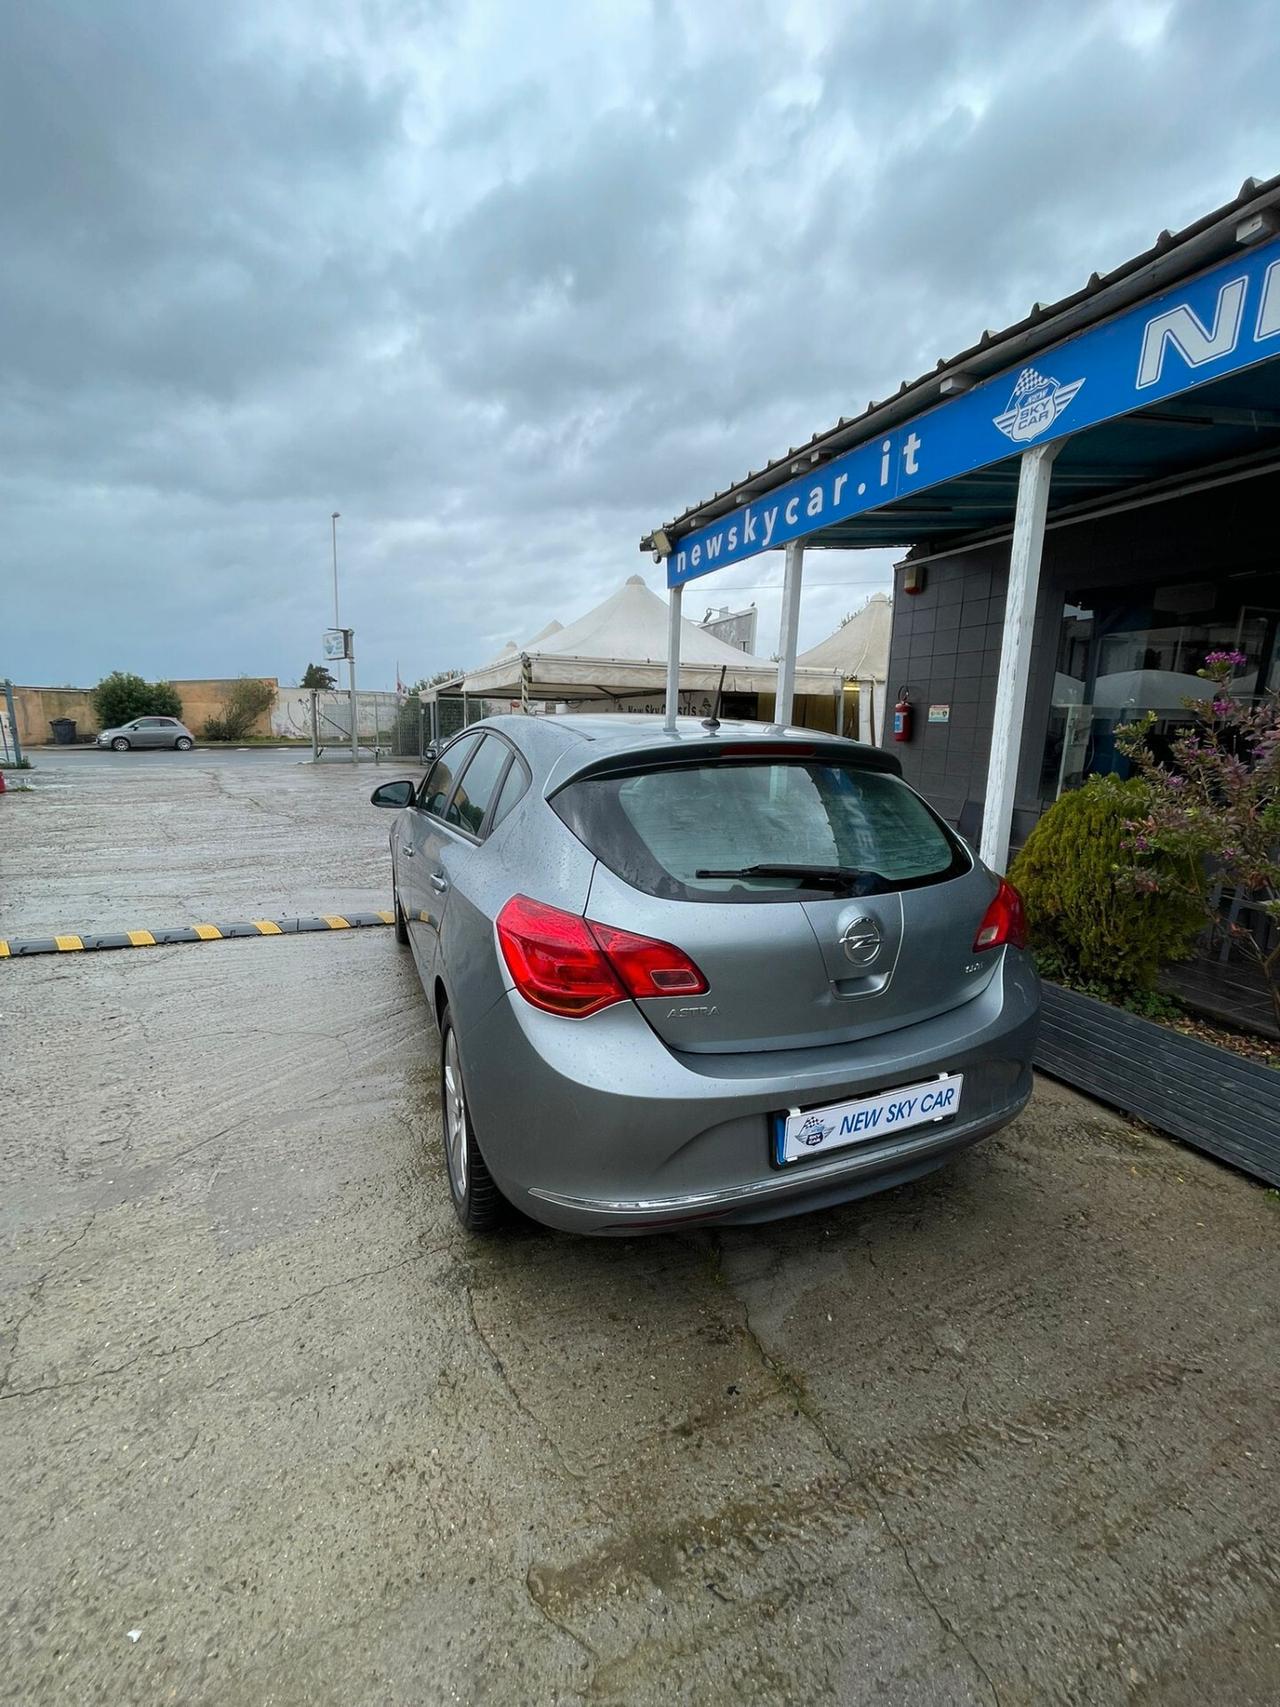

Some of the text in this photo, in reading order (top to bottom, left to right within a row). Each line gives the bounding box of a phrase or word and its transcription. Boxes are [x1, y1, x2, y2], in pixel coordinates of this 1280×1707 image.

[1020, 399, 1051, 420] SKY
[1018, 410, 1049, 431] CAR
[676, 432, 922, 573] newskycar.it
[667, 1006, 720, 1019] ASTRA
[840, 1088, 955, 1135] NEW SKY CAR
